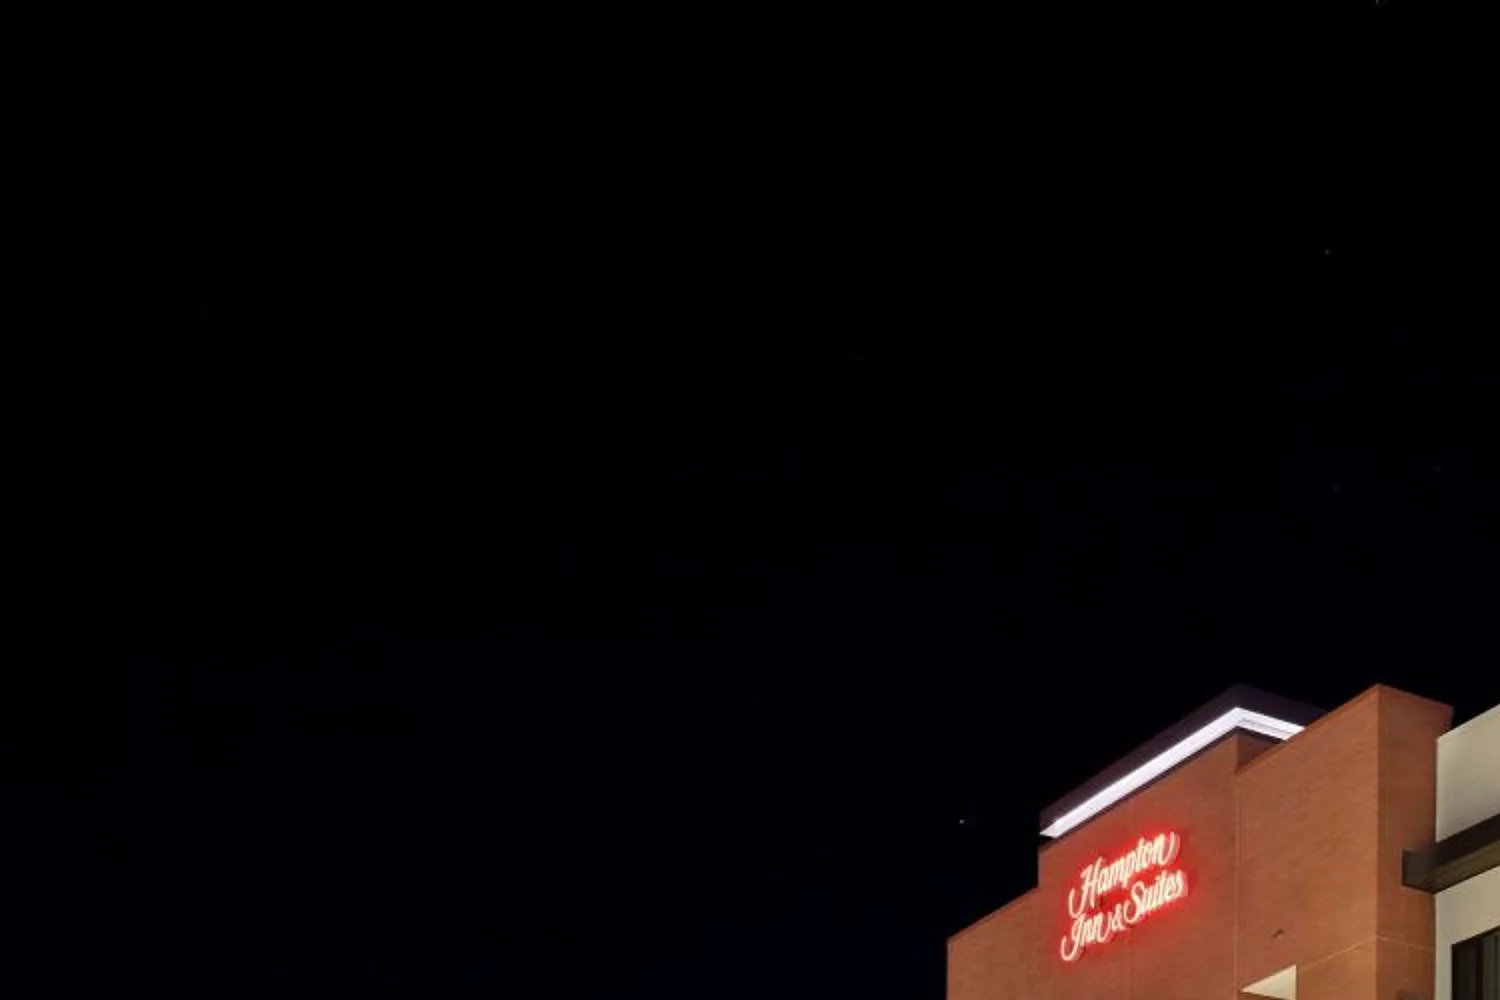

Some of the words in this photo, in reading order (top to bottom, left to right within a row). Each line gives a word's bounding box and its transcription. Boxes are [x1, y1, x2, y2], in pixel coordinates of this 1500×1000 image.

[1061, 911, 1113, 961] Inn
[1123, 869, 1185, 924] Suites
[1068, 831, 1176, 919] Hampton
